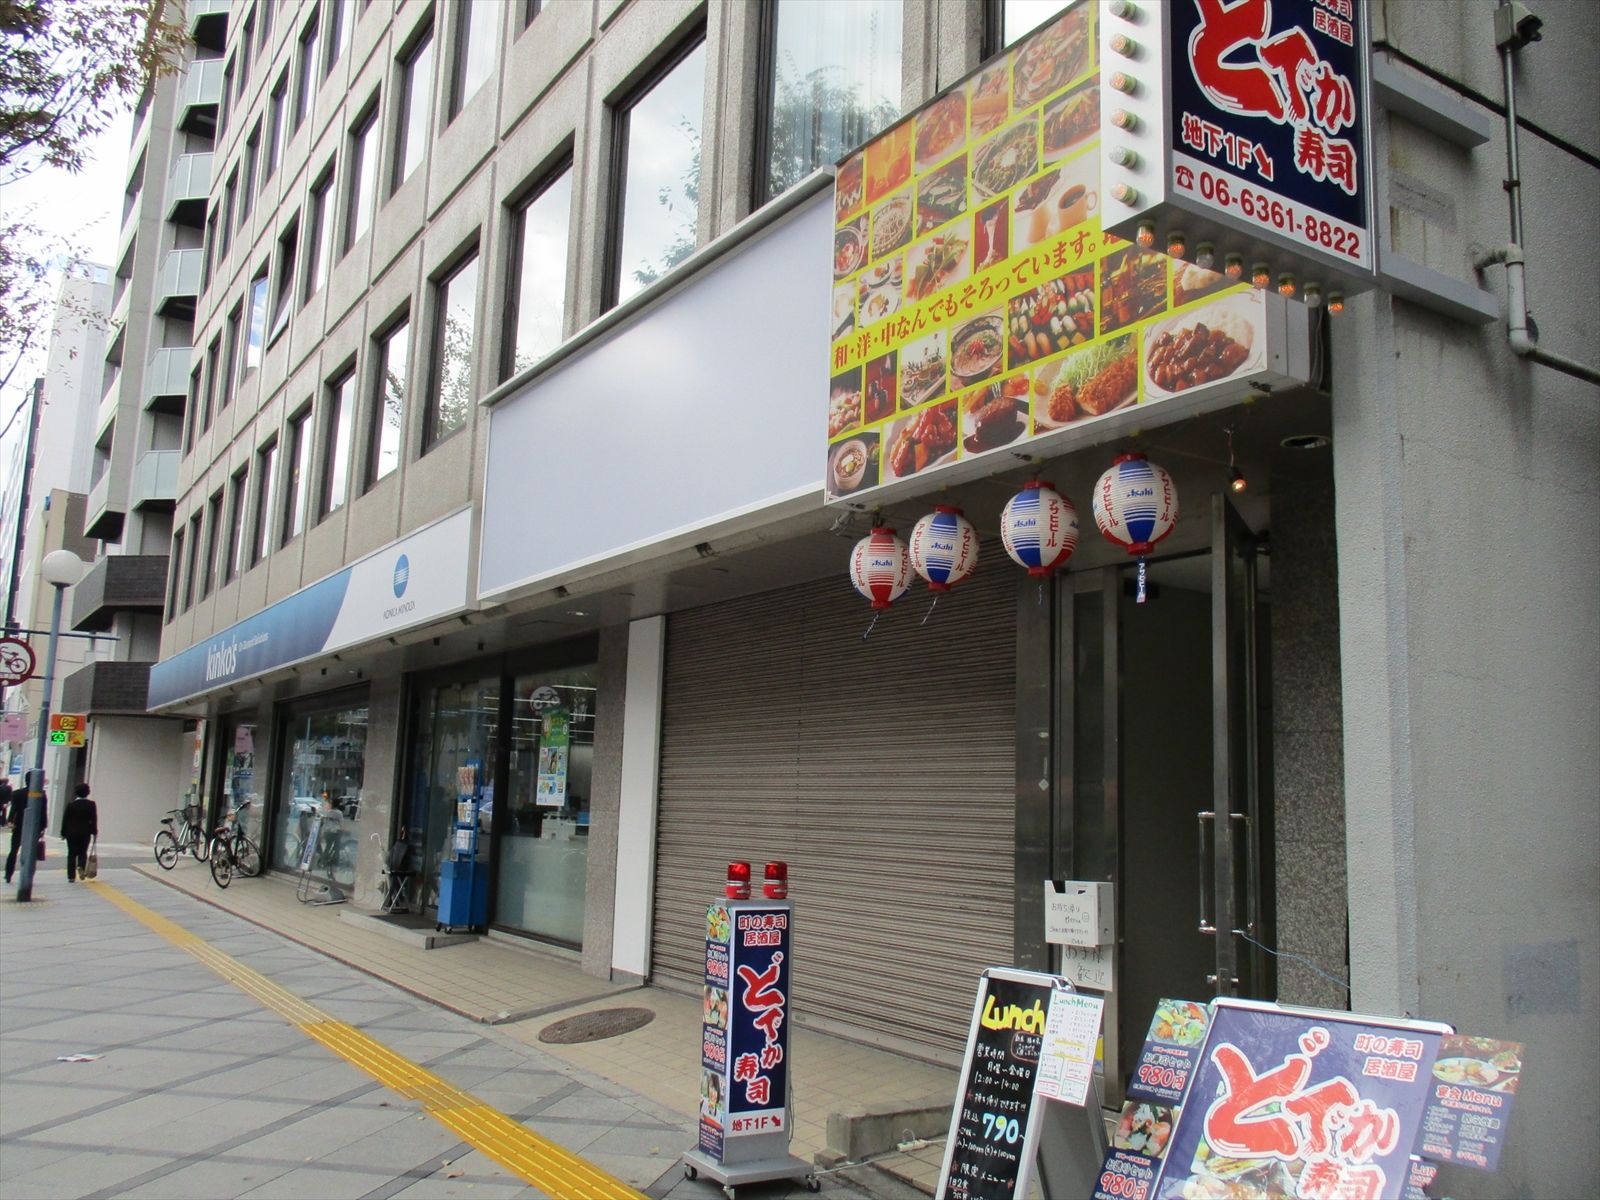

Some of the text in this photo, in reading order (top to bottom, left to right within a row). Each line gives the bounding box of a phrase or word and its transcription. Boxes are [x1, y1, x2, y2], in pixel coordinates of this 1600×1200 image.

[1313, 7, 1353, 47] 居酒屋
[1182, 112, 1252, 169] 地下1F
[1295, 125, 1357, 195] 寿司
[1199, 171, 1361, 260] 06-6361-8822
[1102, 474, 1119, 528] アサヒビール
[1126, 487, 1153, 498] Asahi
[1013, 518, 1036, 529] Asahi
[1046, 498, 1060, 548] アサヒビール
[931, 541, 953, 551] Asahi
[872, 559, 893, 568] Asahi
[206, 634, 238, 682] kinko's
[738, 914, 787, 930] 町の寿司
[743, 929, 781, 946] 居酒屋
[981, 994, 1045, 1035] Lunch
[1354, 1033, 1424, 1059] 町の寿司
[1138, 1064, 1186, 1091] 980円
[1362, 1057, 1418, 1082] 居酒屋
[1462, 1089, 1503, 1107] Menu
[731, 1116, 769, 1132] 地下1F
